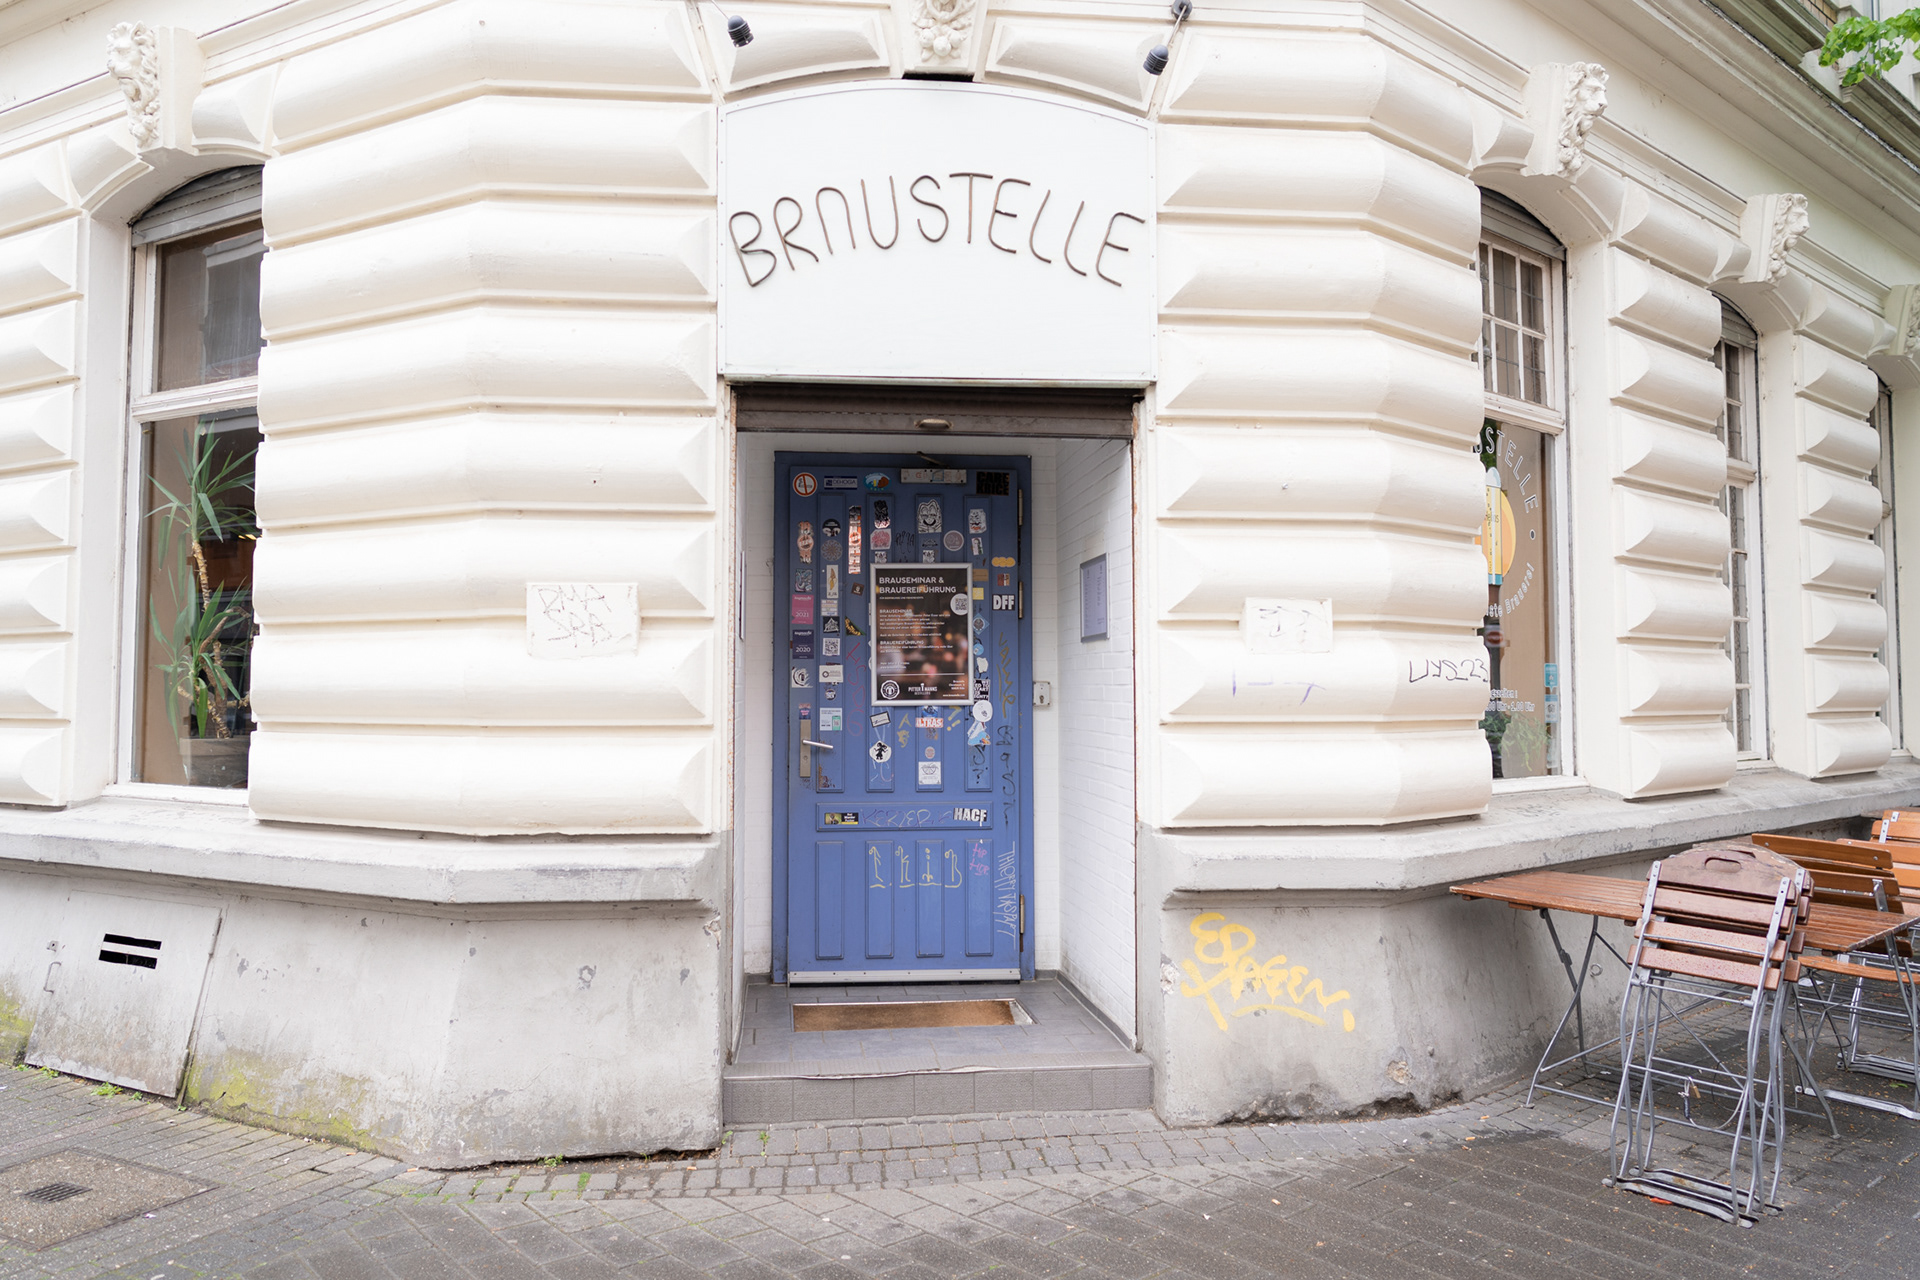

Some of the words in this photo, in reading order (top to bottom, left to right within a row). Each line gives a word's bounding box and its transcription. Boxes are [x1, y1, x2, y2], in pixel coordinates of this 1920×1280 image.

[879, 576, 937, 584] BRAUSEMINAR
[938, 576, 945, 584] &
[879, 584, 957, 594] BRAUEREIFÜHRUNG
[1505, 562, 1535, 614] Brauerei
[992, 595, 1015, 610] DFF
